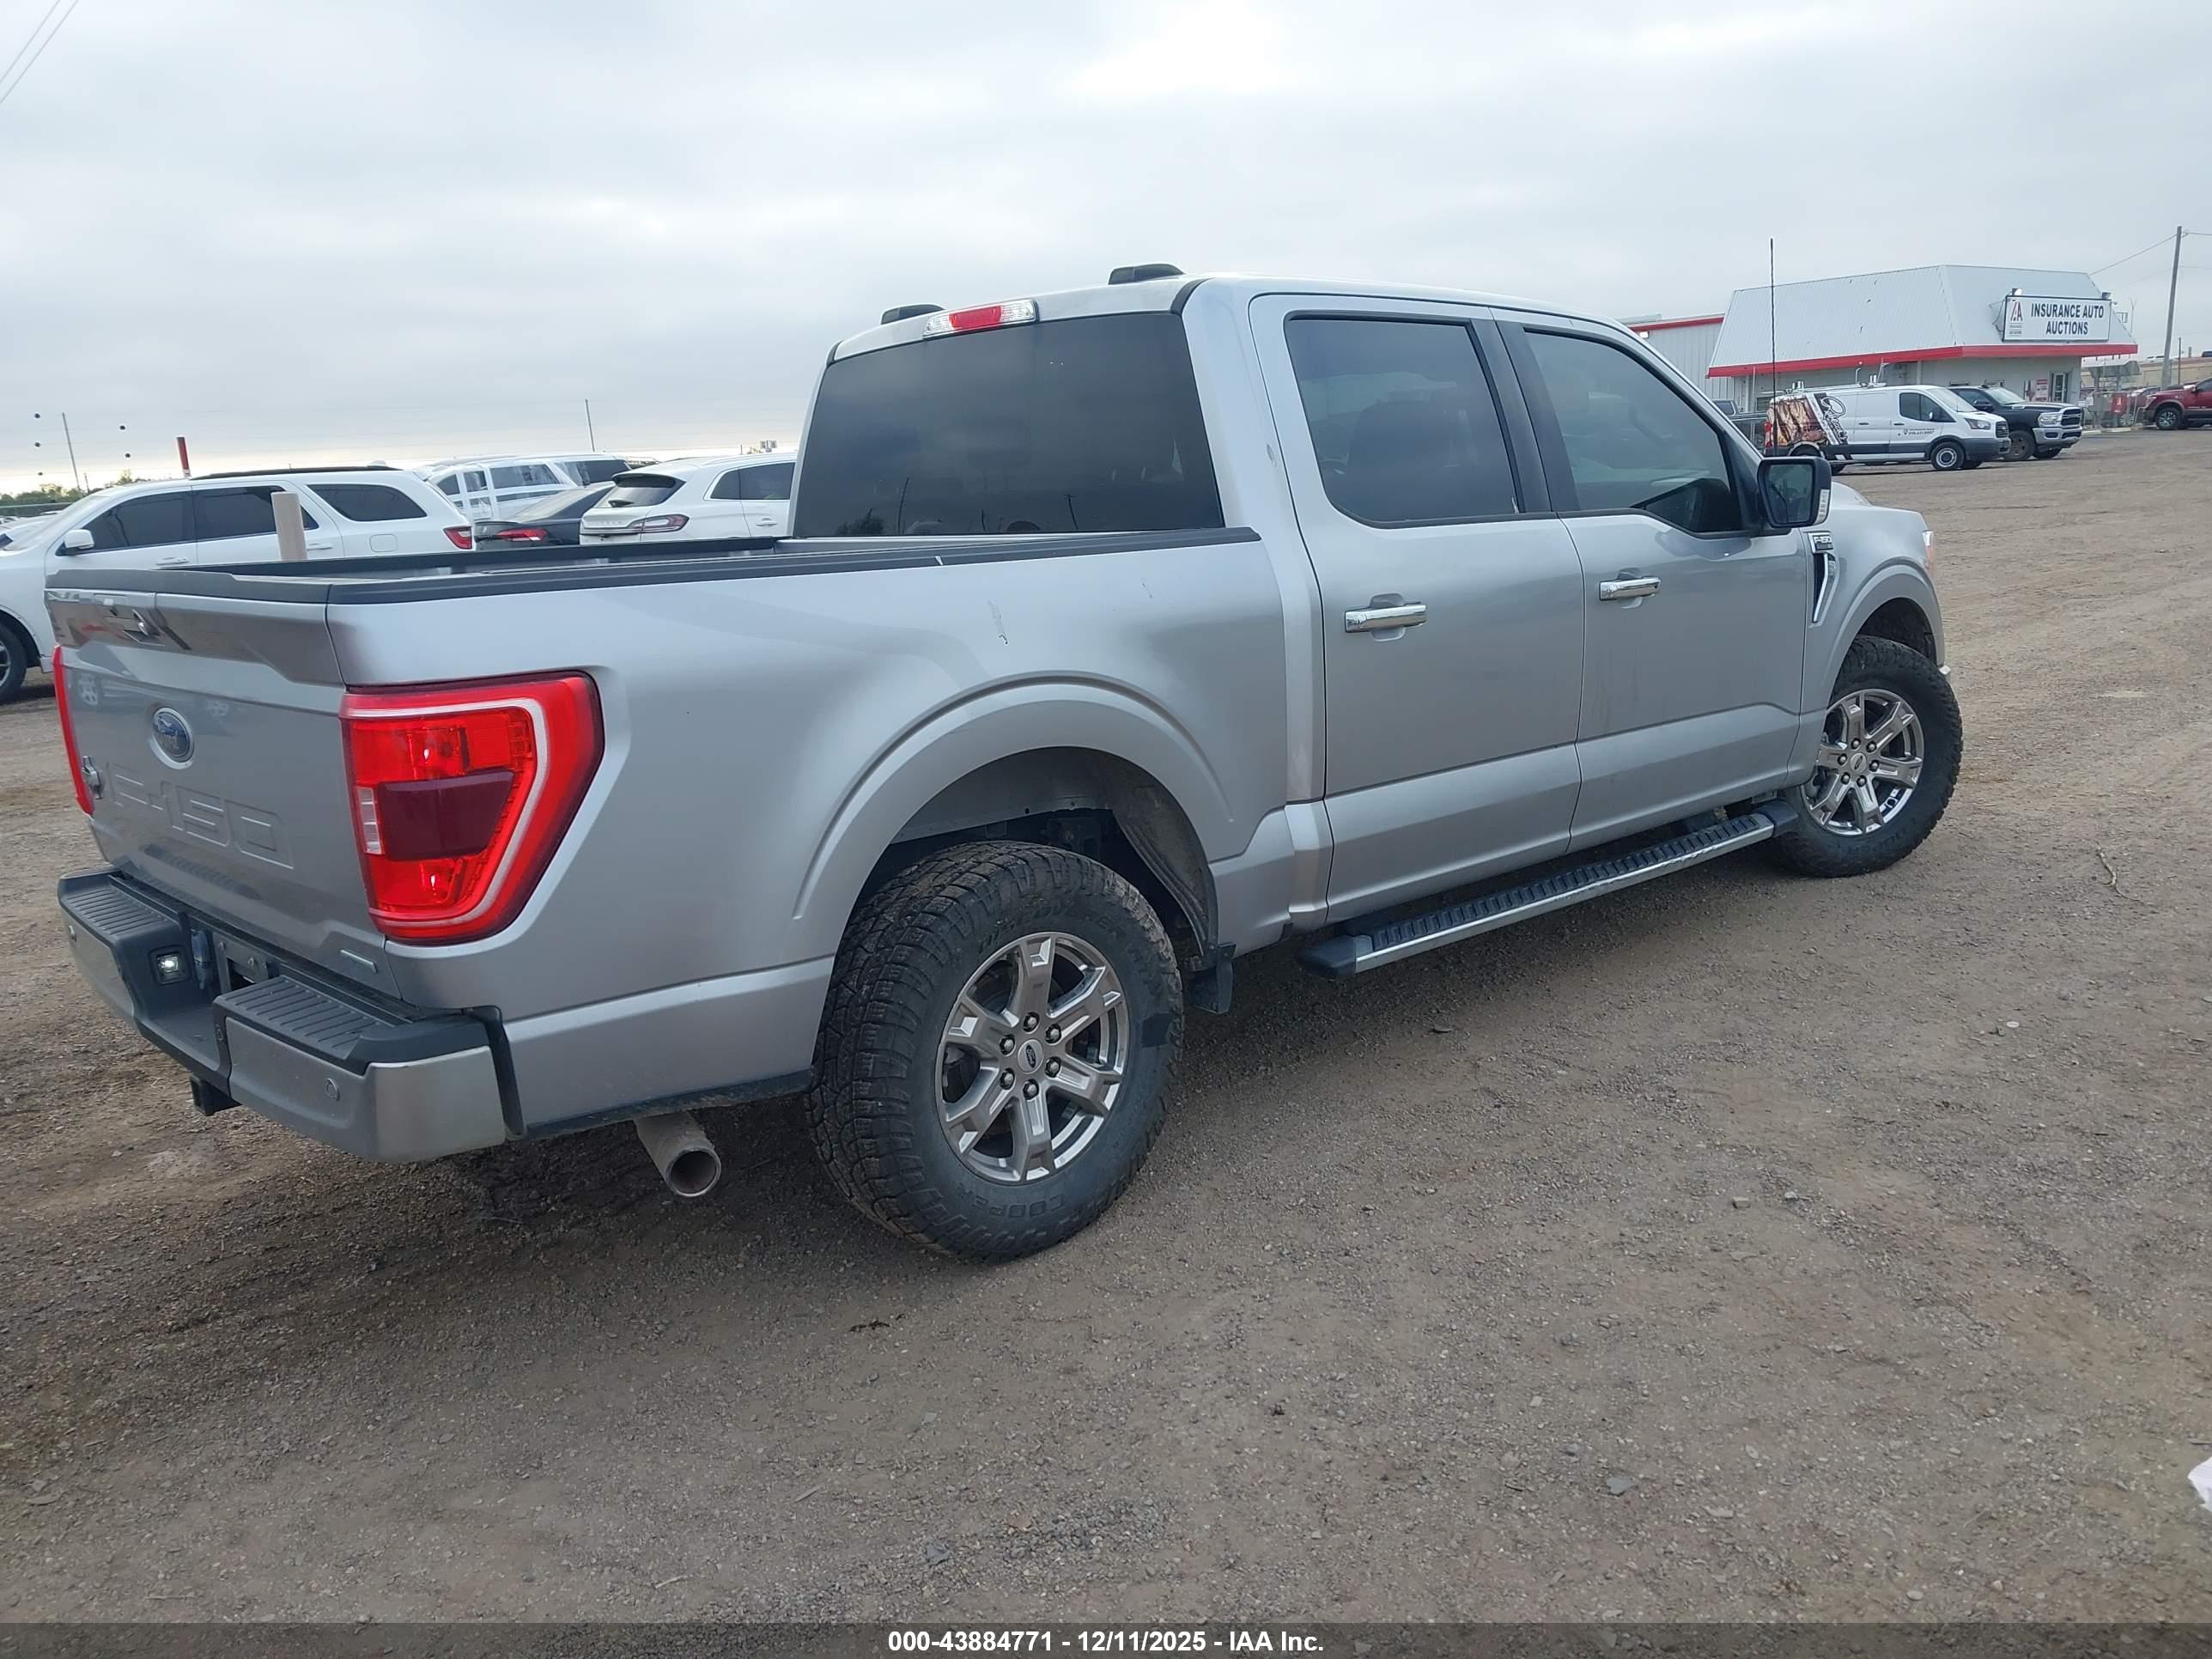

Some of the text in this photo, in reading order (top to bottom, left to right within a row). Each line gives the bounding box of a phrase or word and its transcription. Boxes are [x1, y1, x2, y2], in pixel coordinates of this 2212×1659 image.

[2031, 302, 2104, 319] INSURANCE AUTO
[2045, 321, 2088, 335] AUCTIONS
[106, 763, 295, 870] F-150
